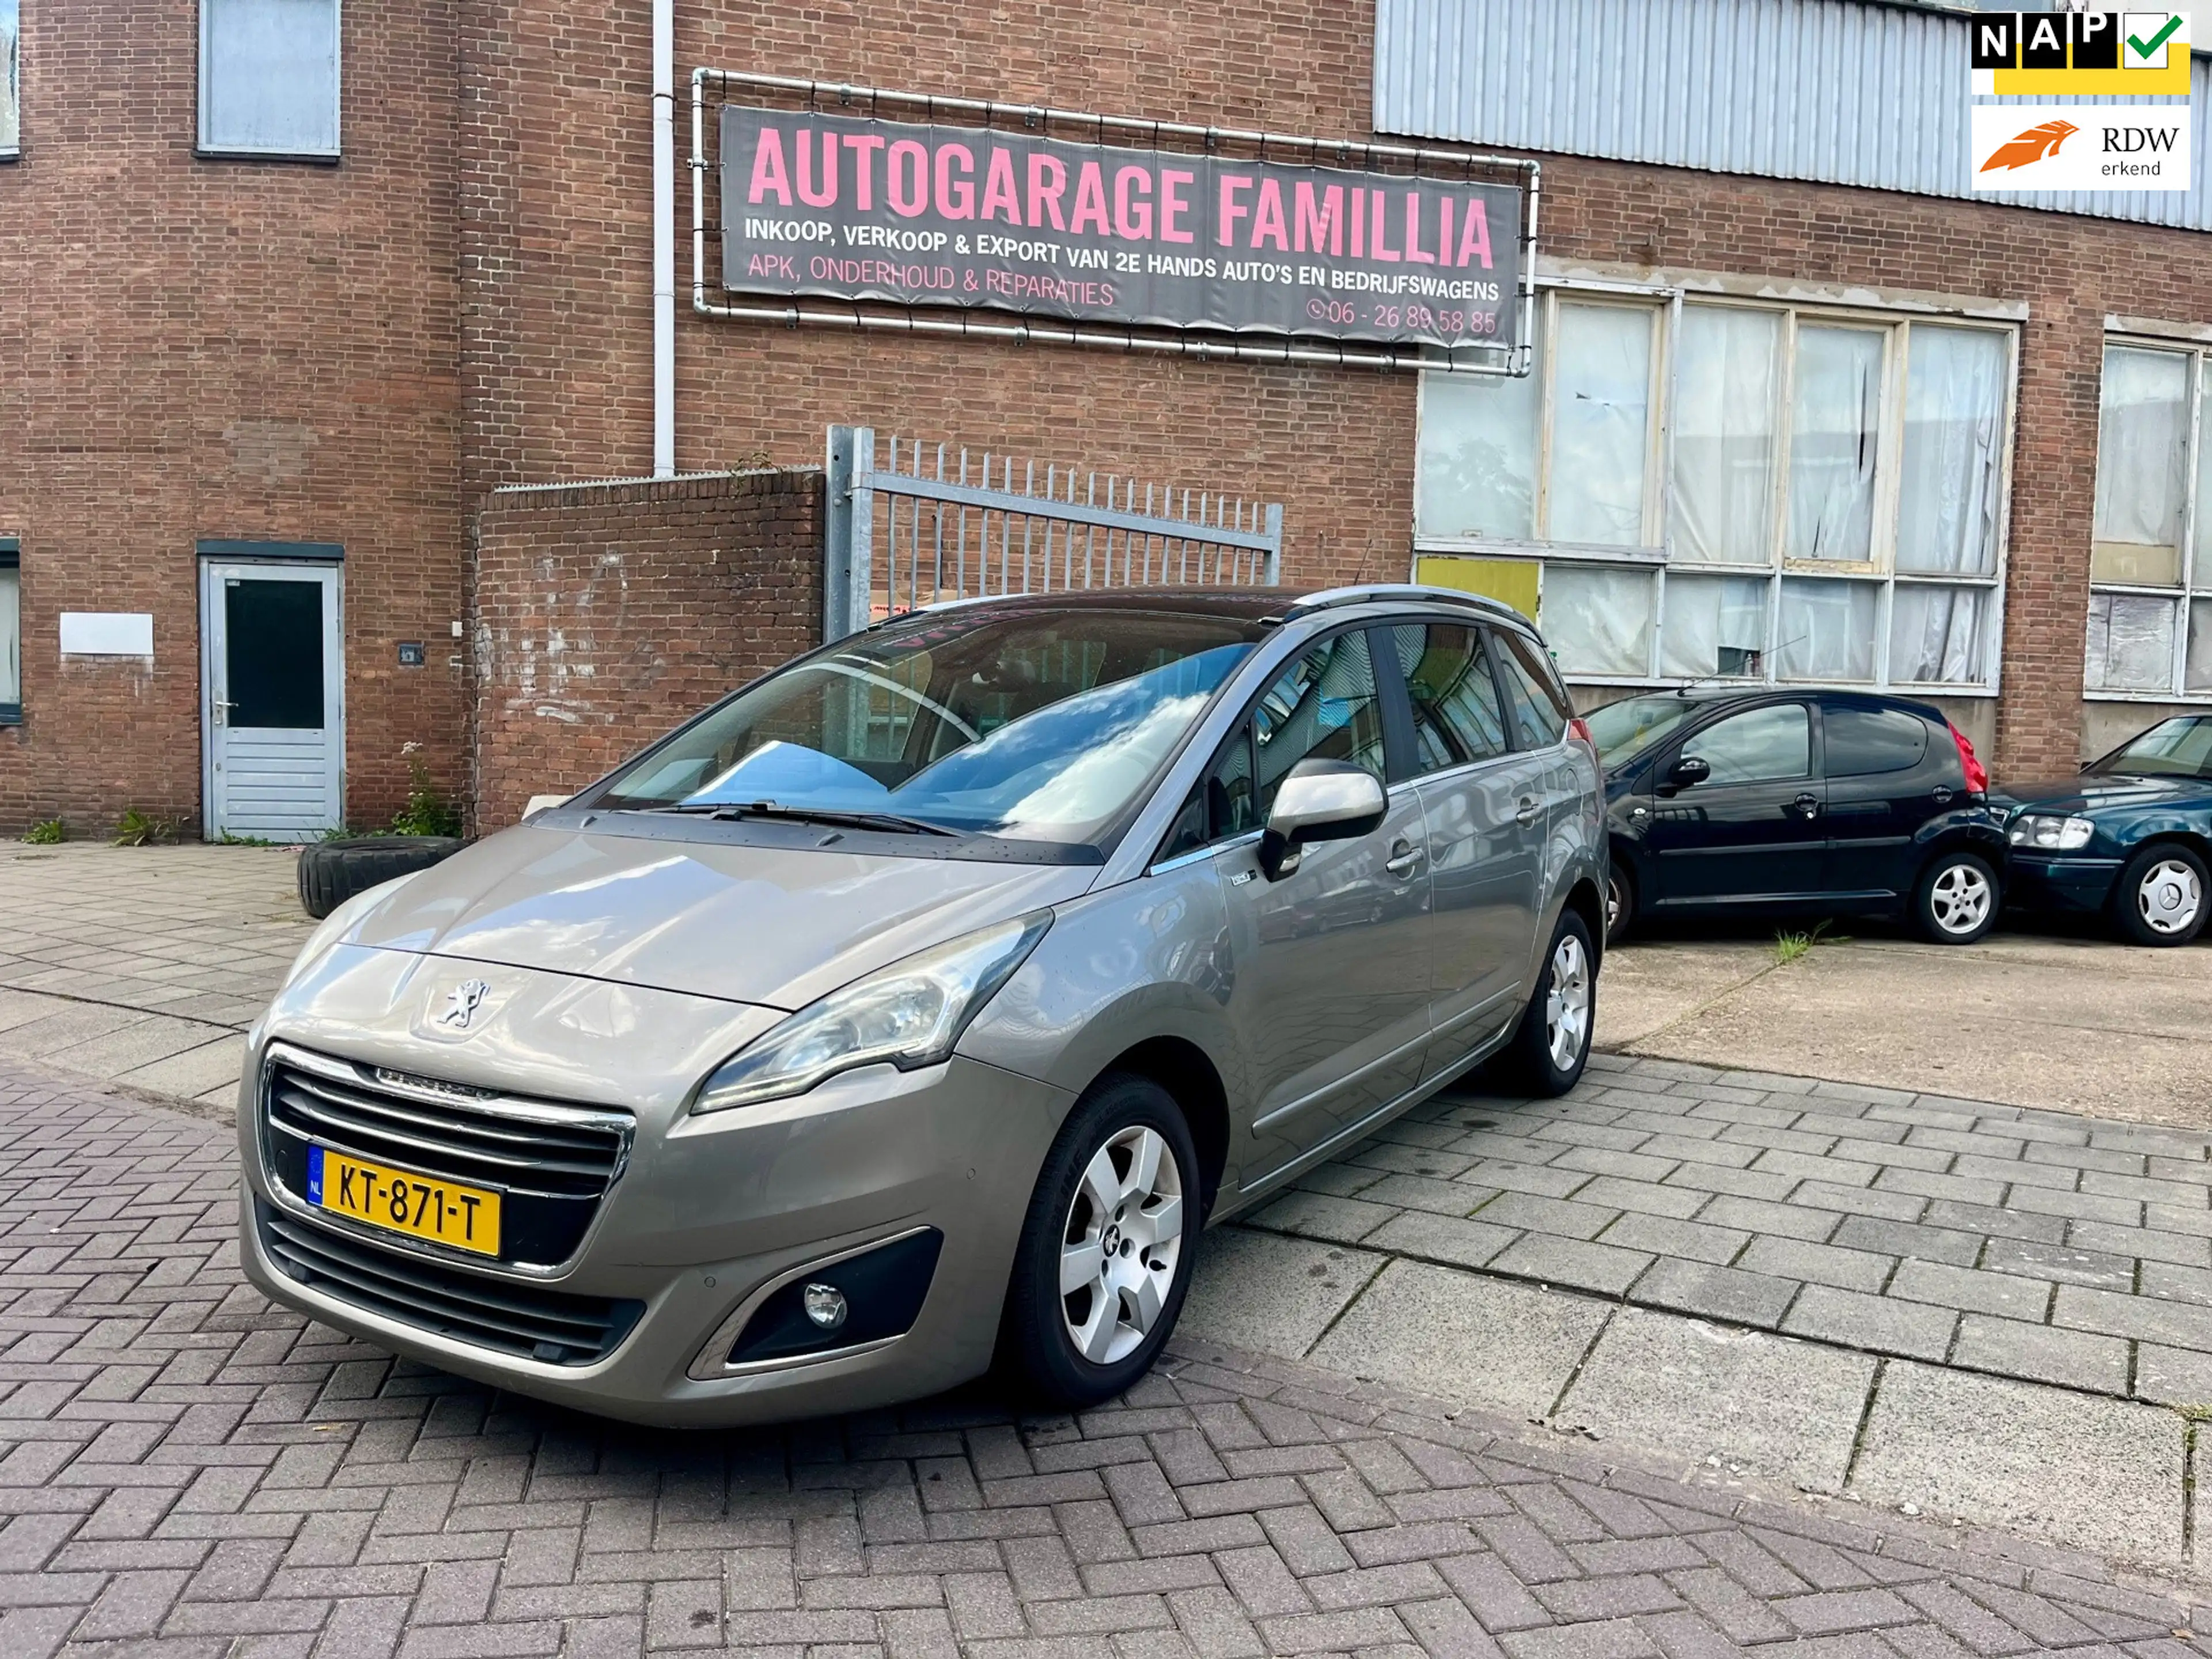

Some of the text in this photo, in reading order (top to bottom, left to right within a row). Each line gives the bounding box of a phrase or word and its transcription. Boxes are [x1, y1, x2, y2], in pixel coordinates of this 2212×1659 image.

[748, 127, 1494, 269] AUTOGARAGE FAMILLIA
[745, 219, 1499, 301] INKOOP, VERKOOP & EXPORT VAN 2E HANDS AUTO'S EN BEDRIJFSWAGENS
[749, 254, 1113, 306] APK, ONDERHOUD & REPARATIES
[1329, 302, 1355, 324] 06
[1374, 305, 1399, 328] 26
[1406, 306, 1431, 328] 89
[1440, 309, 1464, 332] 58
[1471, 312, 1495, 334] 85
[310, 1180, 321, 1196] NL
[340, 1164, 481, 1240] KT-871-T
